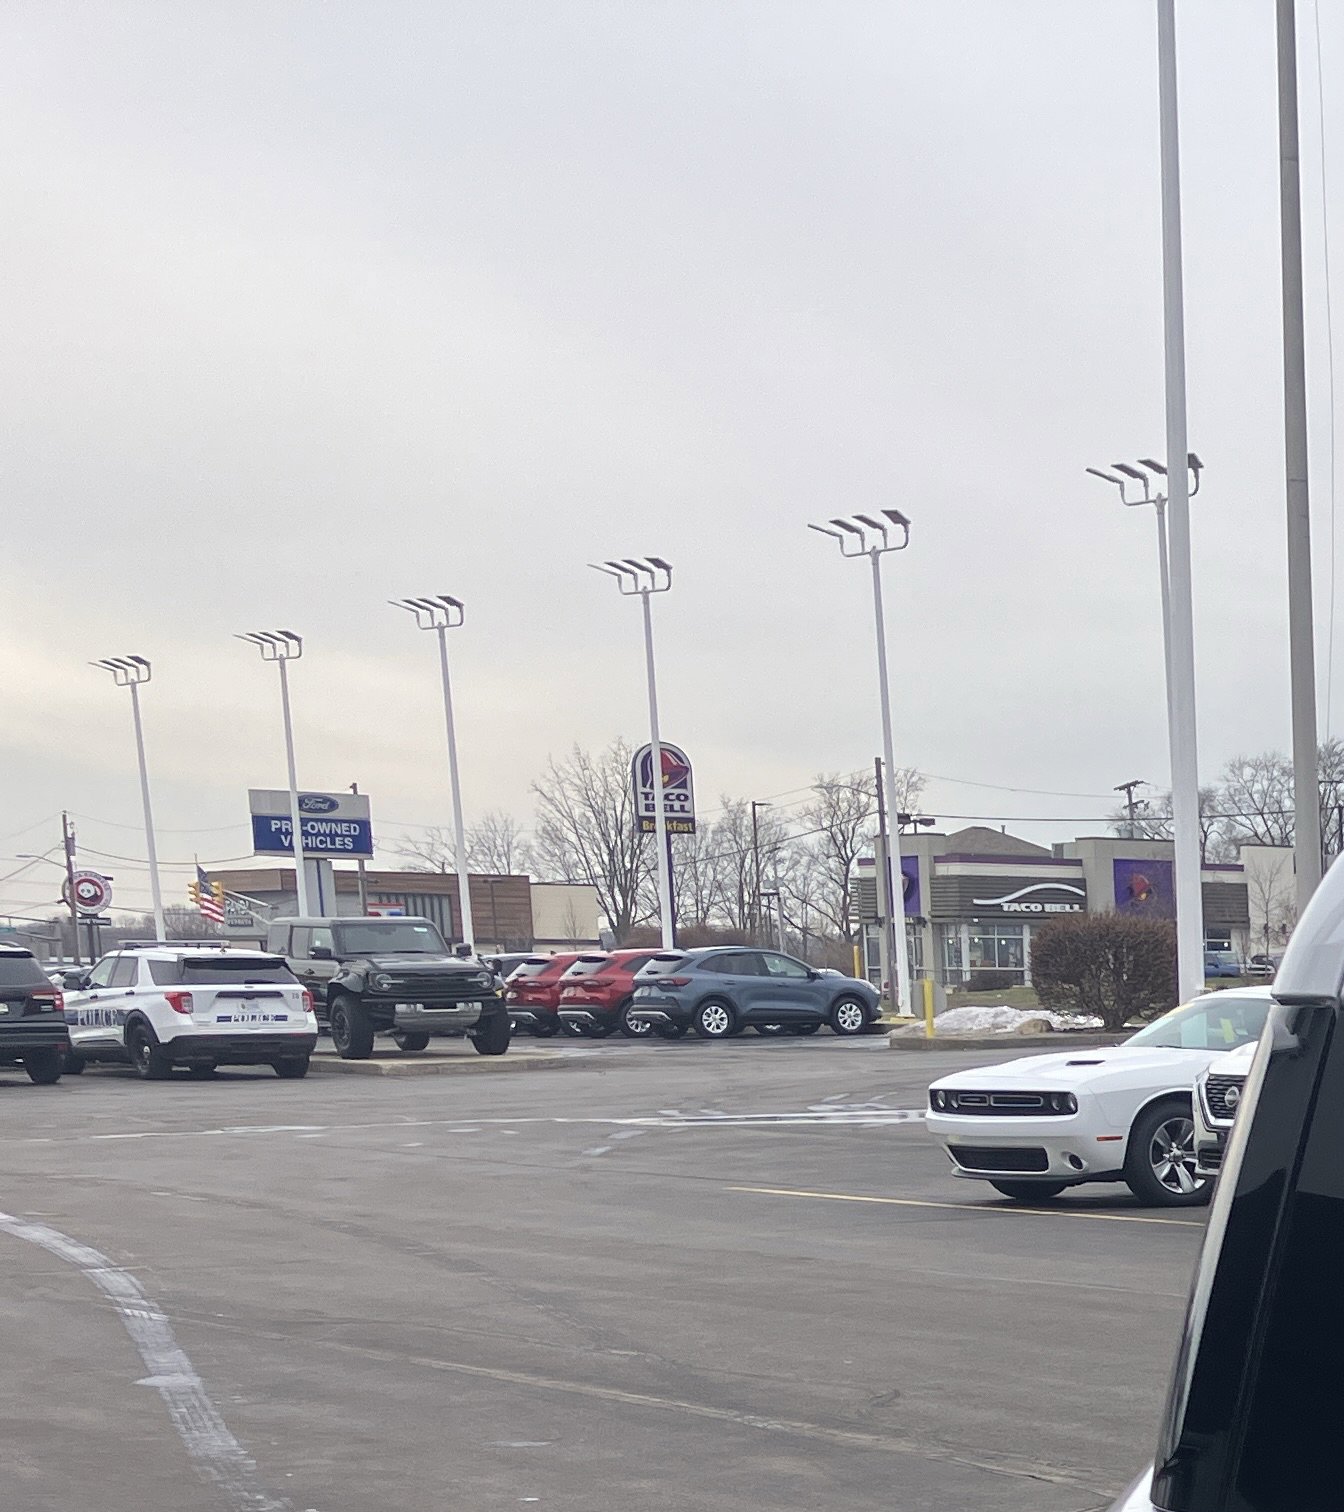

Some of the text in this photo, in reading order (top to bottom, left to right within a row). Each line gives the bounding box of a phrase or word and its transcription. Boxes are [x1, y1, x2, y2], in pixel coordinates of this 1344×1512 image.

[302, 798, 330, 810] Ford
[270, 820, 360, 836] PR-OWNED
[642, 820, 693, 832] Brkfast
[280, 835, 354, 850] VHICLES
[1001, 902, 1084, 913] TACO BELL
